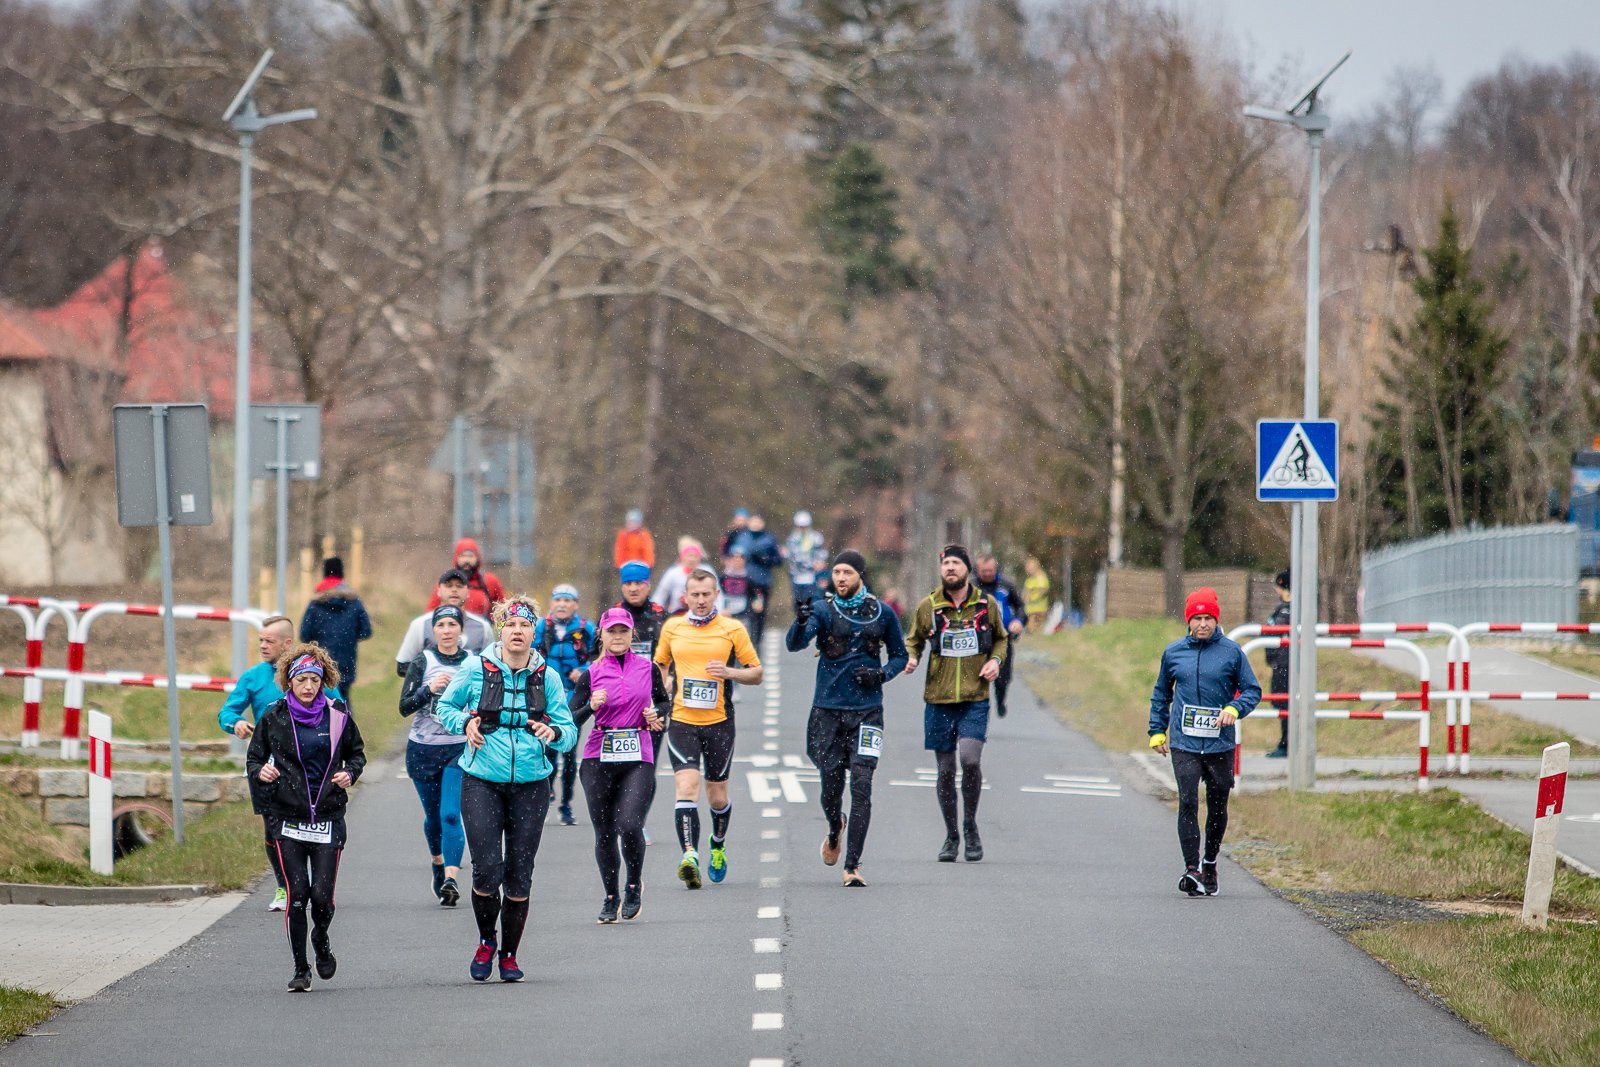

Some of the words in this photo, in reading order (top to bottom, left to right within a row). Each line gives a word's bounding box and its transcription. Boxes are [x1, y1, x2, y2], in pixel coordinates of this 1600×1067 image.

[954, 637, 974, 649] 692
[693, 688, 713, 700] 461
[1195, 716, 1218, 729] 443
[615, 739, 637, 752] 266
